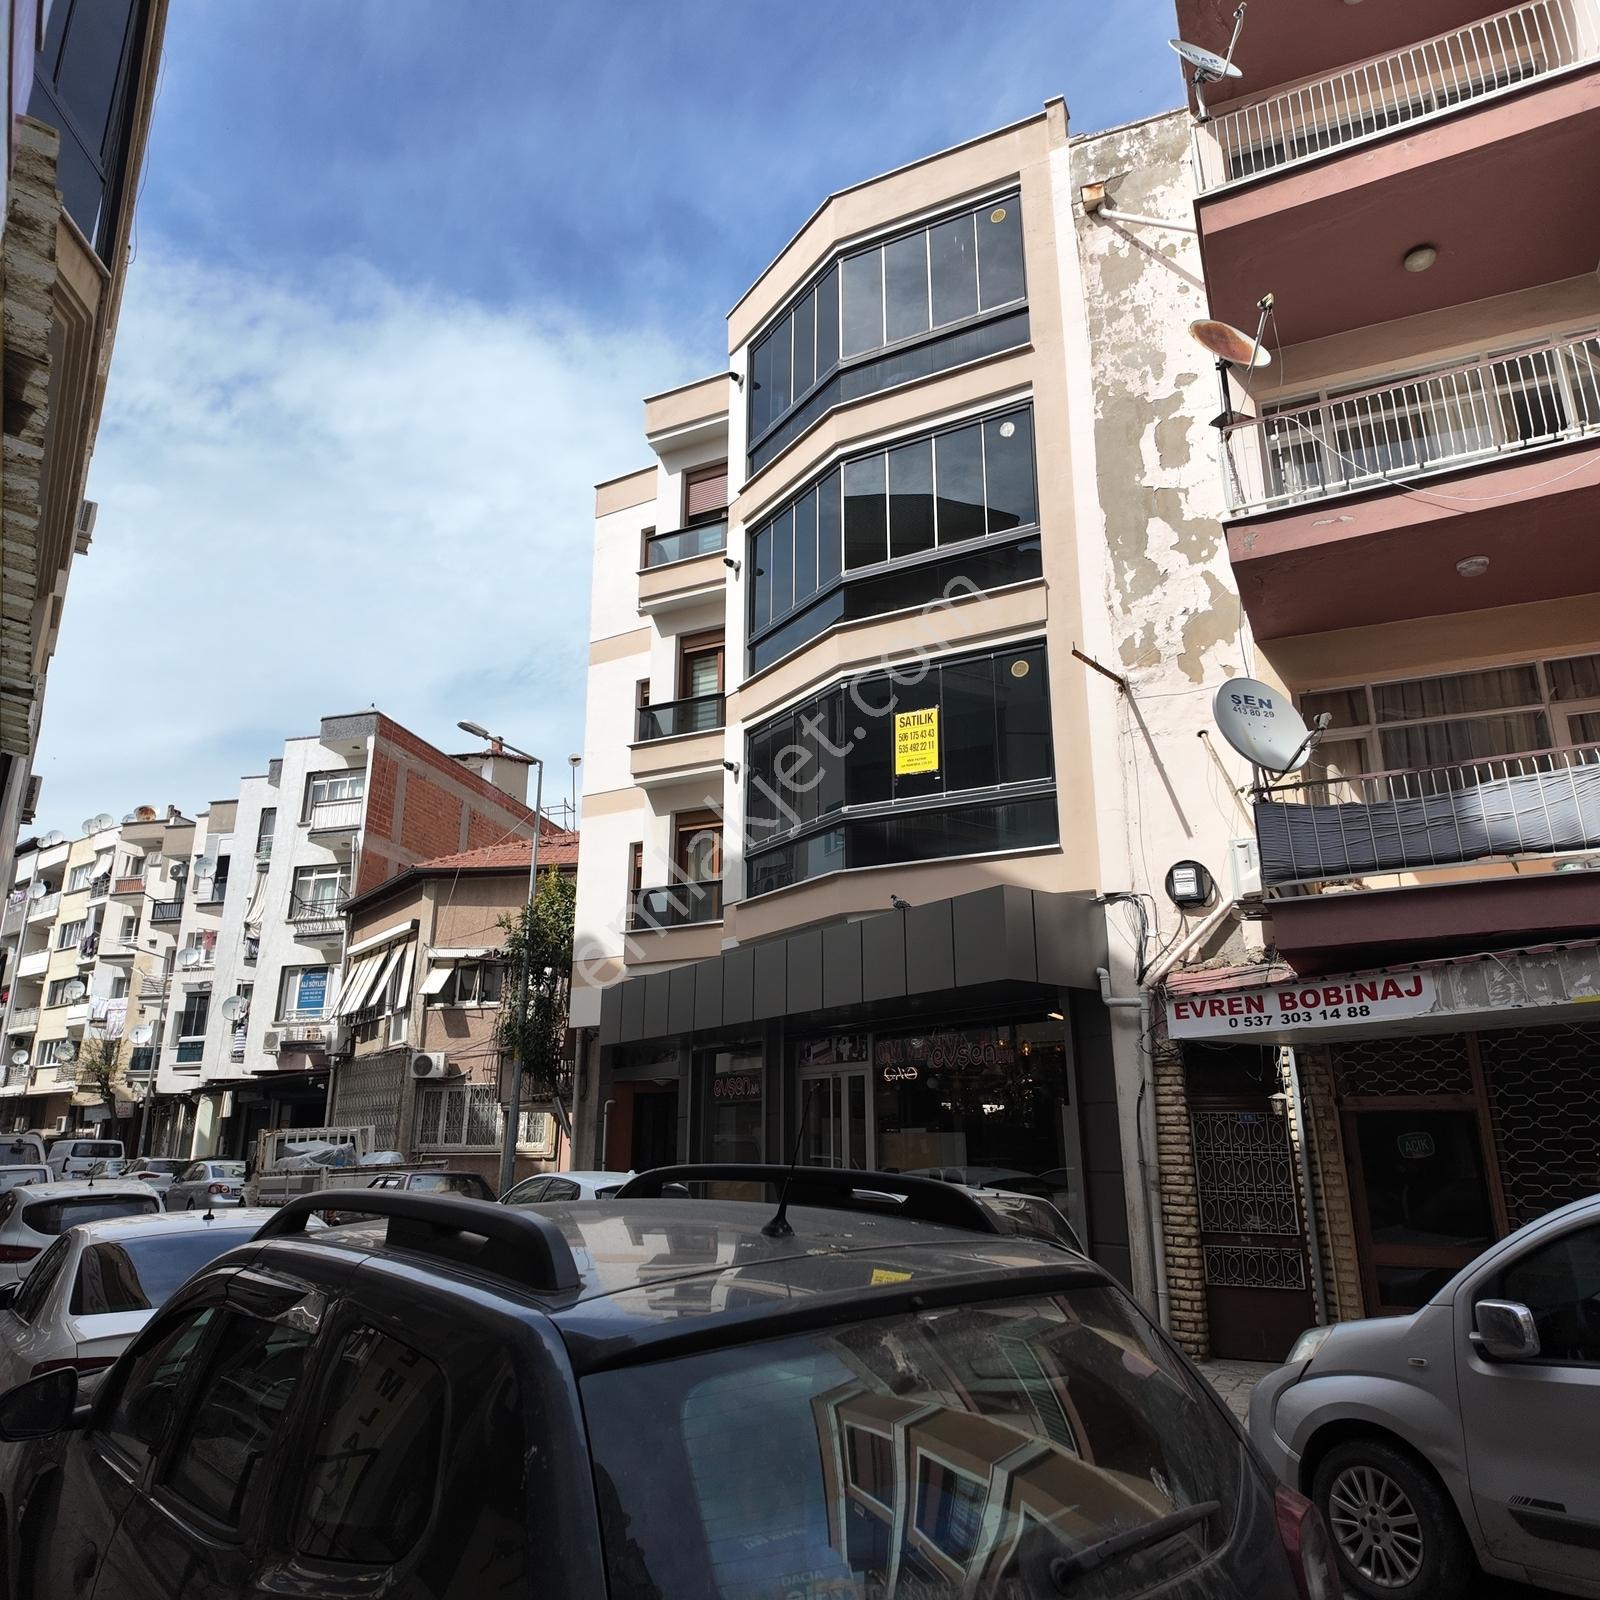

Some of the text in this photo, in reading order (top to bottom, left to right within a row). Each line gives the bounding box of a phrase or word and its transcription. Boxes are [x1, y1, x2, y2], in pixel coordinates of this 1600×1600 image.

[1232, 705, 1248, 715] 413
[1249, 709, 1261, 717] 80
[1263, 710, 1275, 718] 29
[899, 712, 934, 728] SATILIK
[898, 728, 935, 742] 506 175 43 43
[898, 740, 934, 754] 535 492 22 11
[1174, 994, 1265, 1020] EVREN
[1228, 1004, 1371, 1028] 0 537 303 14 88
